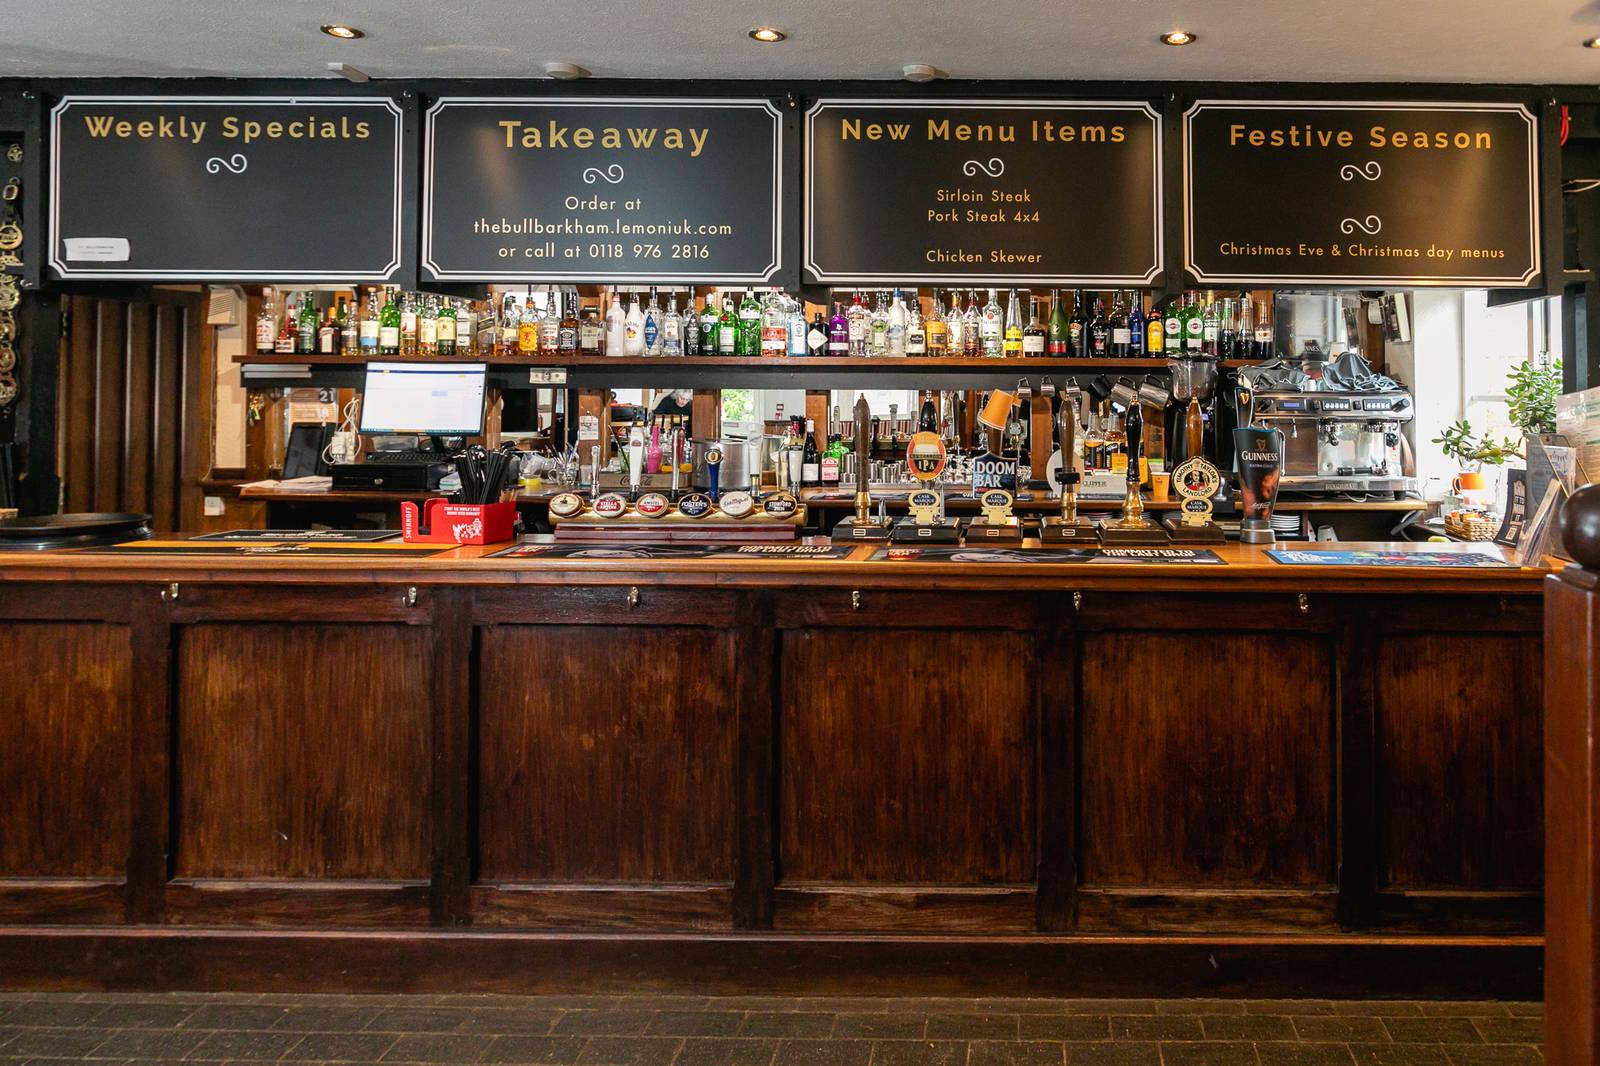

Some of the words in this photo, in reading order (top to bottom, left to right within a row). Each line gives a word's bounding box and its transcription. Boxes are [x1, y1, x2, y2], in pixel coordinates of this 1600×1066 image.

[85, 116, 206, 143] Weekly
[223, 117, 369, 143] Specials
[842, 119, 910, 140] New
[928, 120, 1014, 142] Menu
[1033, 121, 1124, 142] Items
[1231, 125, 1353, 147] Festive
[1370, 127, 1490, 149] Season
[498, 121, 708, 156] Takeaway
[565, 195, 616, 209] Order
[625, 199, 640, 210] at
[937, 189, 983, 201] Sirloin
[992, 189, 1030, 201] Steak
[929, 209, 958, 221] Pork
[967, 209, 1005, 221] Steak
[1014, 211, 1039, 222] 4x4
[474, 218, 731, 234] thebullbarkham.lemoniuk.com
[499, 248, 516, 258] or
[525, 243, 554, 258] call
[565, 246, 580, 257] at
[590, 244, 623, 257] 0118
[634, 245, 661, 258] 976
[672, 245, 708, 258] 2816
[927, 249, 982, 262] Chicken
[991, 250, 1041, 262] Skewer
[1220, 242, 1291, 255] Christmas
[1300, 244, 1323, 255] Eve
[1332, 245, 1341, 256] &
[1349, 244, 1419, 257] Christmas
[1427, 244, 1453, 260] day
[1461, 250, 1504, 258] menus
[1241, 450, 1278, 461] GUINNESS
[918, 460, 935, 471] IPA
[976, 461, 1015, 475] DOOM
[976, 474, 1002, 488] BAR
[1176, 464, 1193, 483] TIMOTHY
[1182, 486, 1213, 496] LANDLORD
